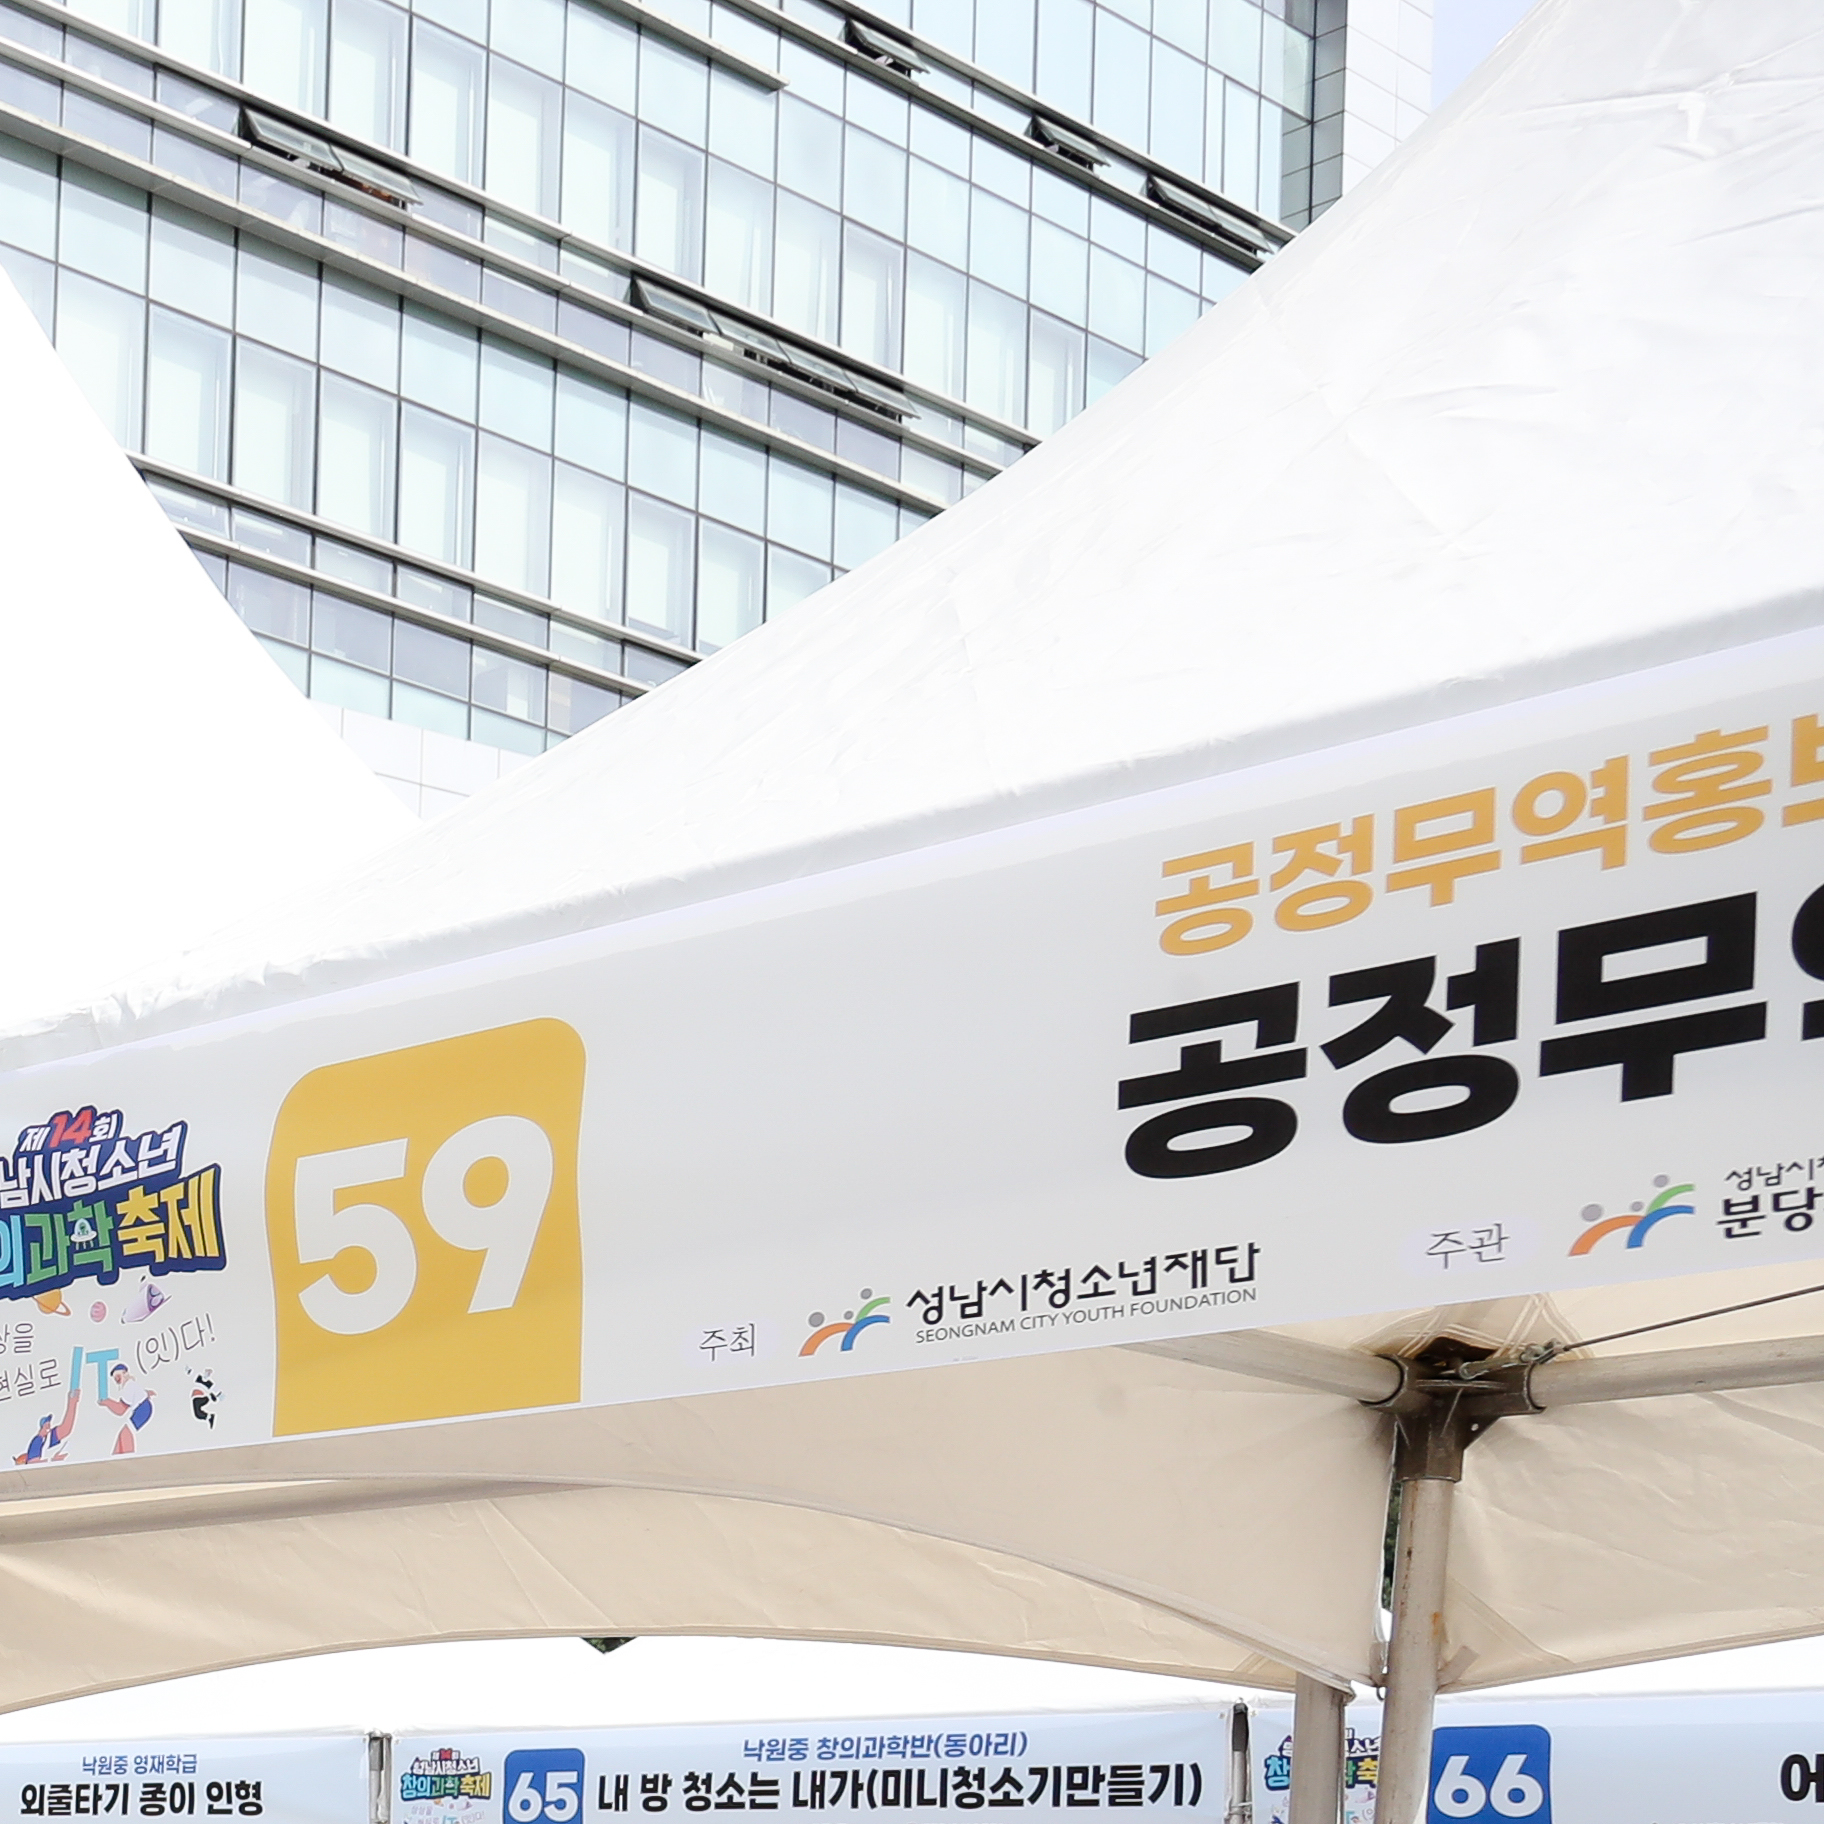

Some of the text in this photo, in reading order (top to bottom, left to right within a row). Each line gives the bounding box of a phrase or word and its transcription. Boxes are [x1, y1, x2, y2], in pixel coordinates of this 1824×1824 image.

[19, 1108, 119, 1153] 제14회
[294, 1113, 555, 1336] 59
[1423, 1221, 1509, 1270] 주관
[905, 1241, 1261, 1325] 성남시청소년재단
[915, 1287, 1257, 1345] SEONGNAM CITY YOUTH FOUNDATION
[698, 1322, 756, 1362] 주최
[82, 1753, 198, 1776] 낙원중 영재학급
[743, 1730, 1028, 1762] 낙원중 창의과학반(동아리)
[20, 1780, 264, 1818] 외줄타기 종이 인형
[507, 1771, 579, 1823] 65
[598, 1761, 1203, 1812] 내 방 청소는 내가(미니청소기만들기)
[1434, 1754, 1544, 1818] 66
